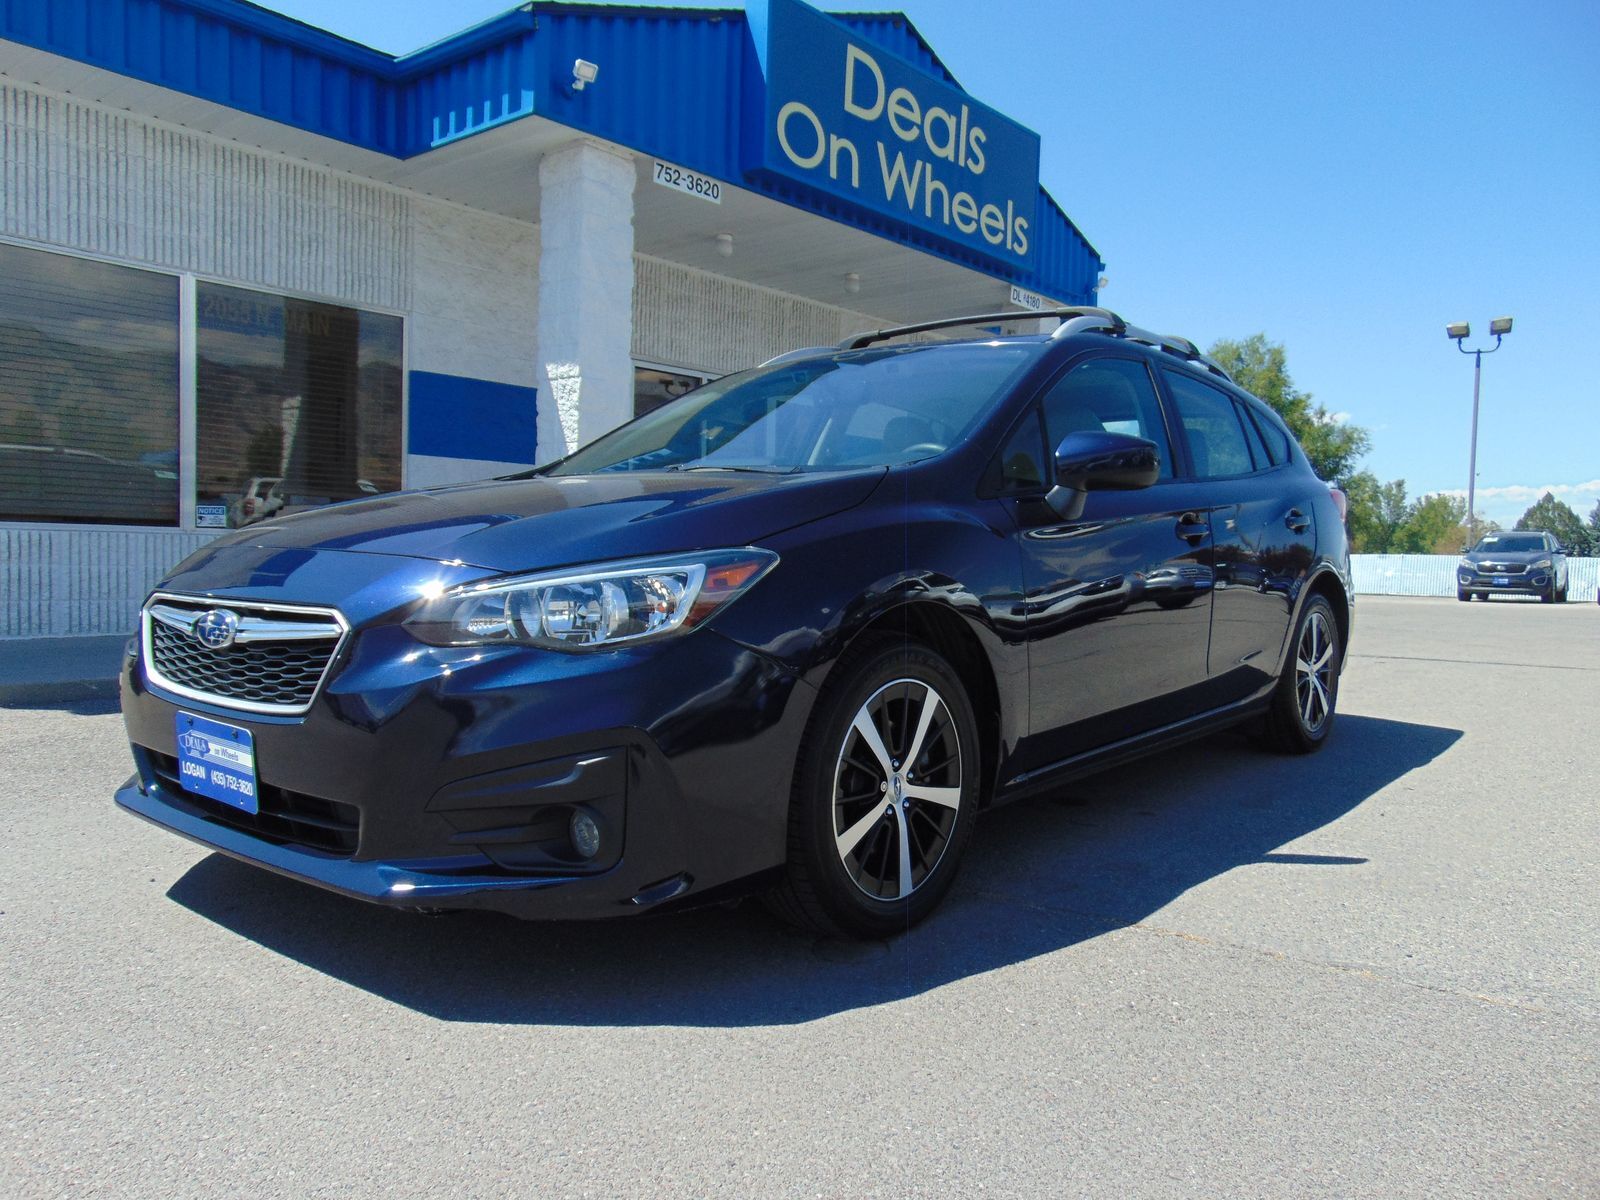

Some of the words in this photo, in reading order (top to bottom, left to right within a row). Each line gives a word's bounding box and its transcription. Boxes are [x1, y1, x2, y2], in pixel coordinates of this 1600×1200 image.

[843, 42, 987, 175] Deals
[655, 162, 719, 199] 752-3620
[776, 101, 859, 188] On
[876, 140, 1029, 256] Wheels
[1012, 288, 1021, 303] DL
[182, 760, 206, 779] LOGAN
[210, 769, 226, 789] (435)
[225, 774, 253, 796] 752-3620
